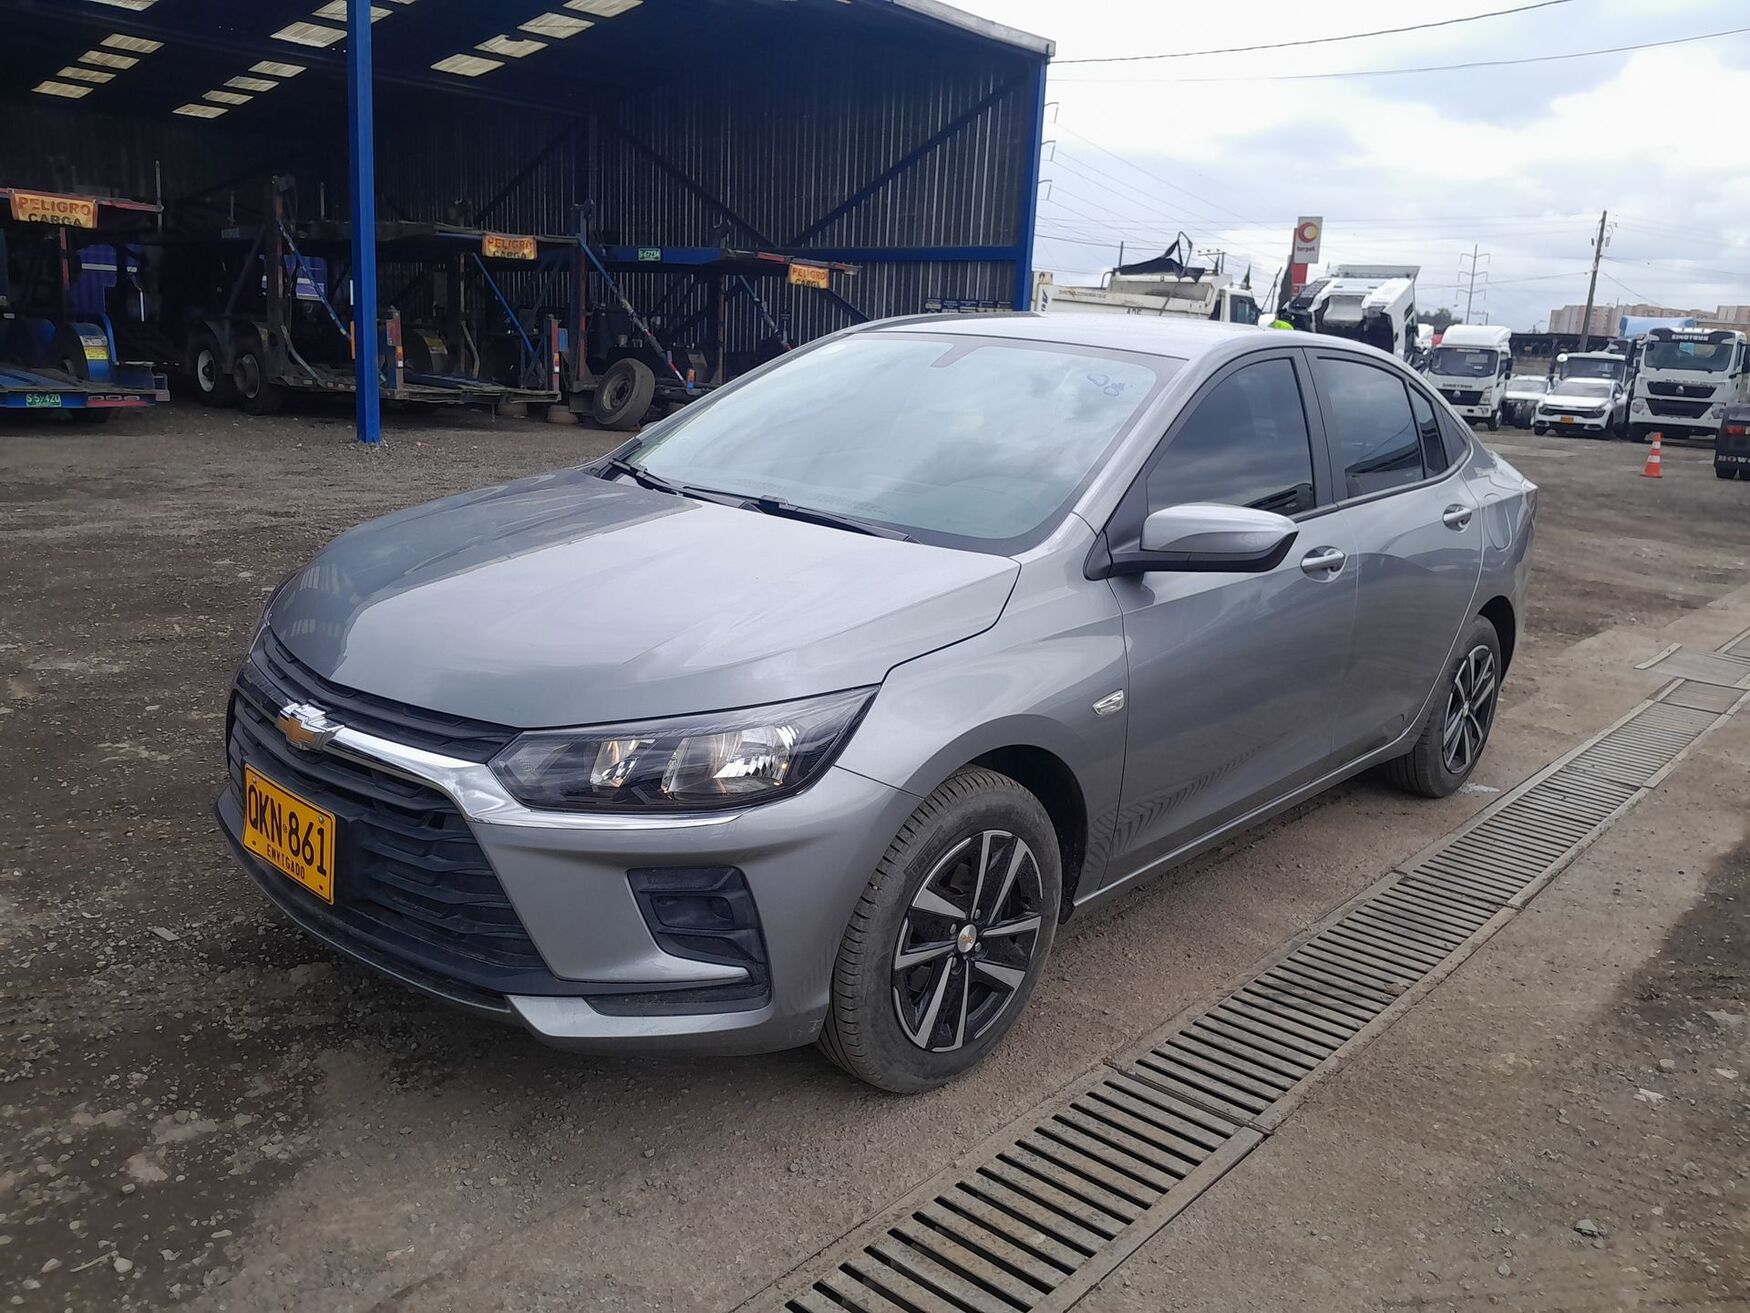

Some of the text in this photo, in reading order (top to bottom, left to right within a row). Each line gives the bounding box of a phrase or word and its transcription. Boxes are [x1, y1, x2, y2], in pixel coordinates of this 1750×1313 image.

[18, 196, 92, 216] PELIGRO
[792, 267, 826, 280] PELIGRO
[1718, 455, 1750, 463] HOW
[266, 843, 306, 880] ENVIGADO
